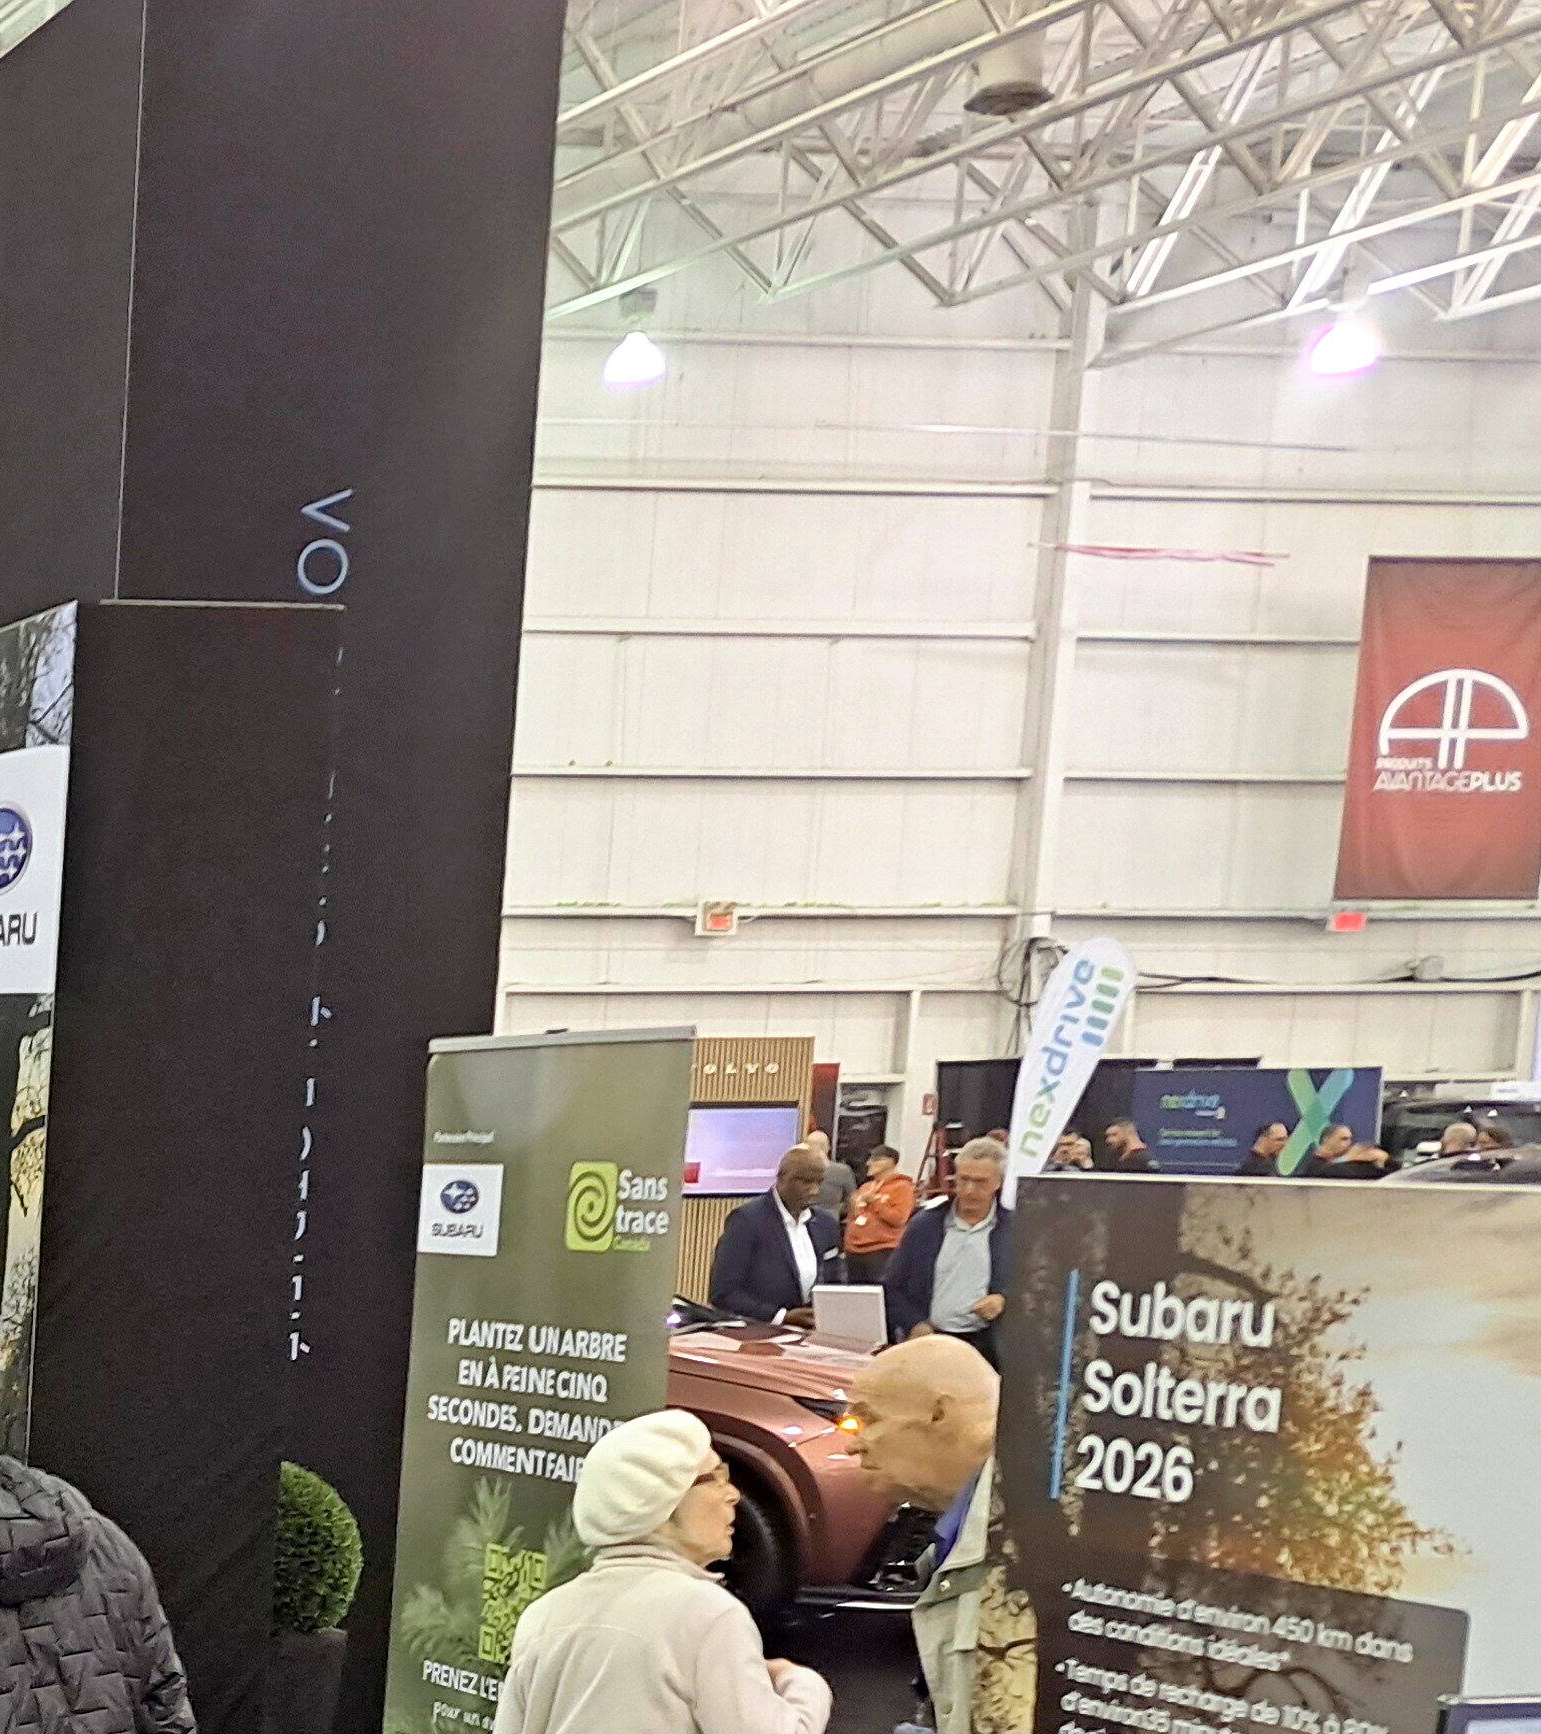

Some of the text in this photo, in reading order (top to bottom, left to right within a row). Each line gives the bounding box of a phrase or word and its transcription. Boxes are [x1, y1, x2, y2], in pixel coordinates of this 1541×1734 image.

[1373, 770, 1522, 792] AVANTAGEPLUS
[1019, 958, 1095, 1157] nexdrive
[618, 1168, 668, 1201] Sans
[616, 1205, 669, 1235] trace
[1090, 1279, 1275, 1349] Subaru
[447, 1317, 628, 1363] PLANTEZ UN ARBRE
[458, 1355, 608, 1404] EN À PEINE CINQ
[1082, 1361, 1282, 1434] Solterra
[427, 1394, 522, 1433] SECONDES.
[450, 1436, 547, 1476] COMMENT
[1075, 1434, 1195, 1503] 2026
[422, 1659, 479, 1695] PRENEZ
